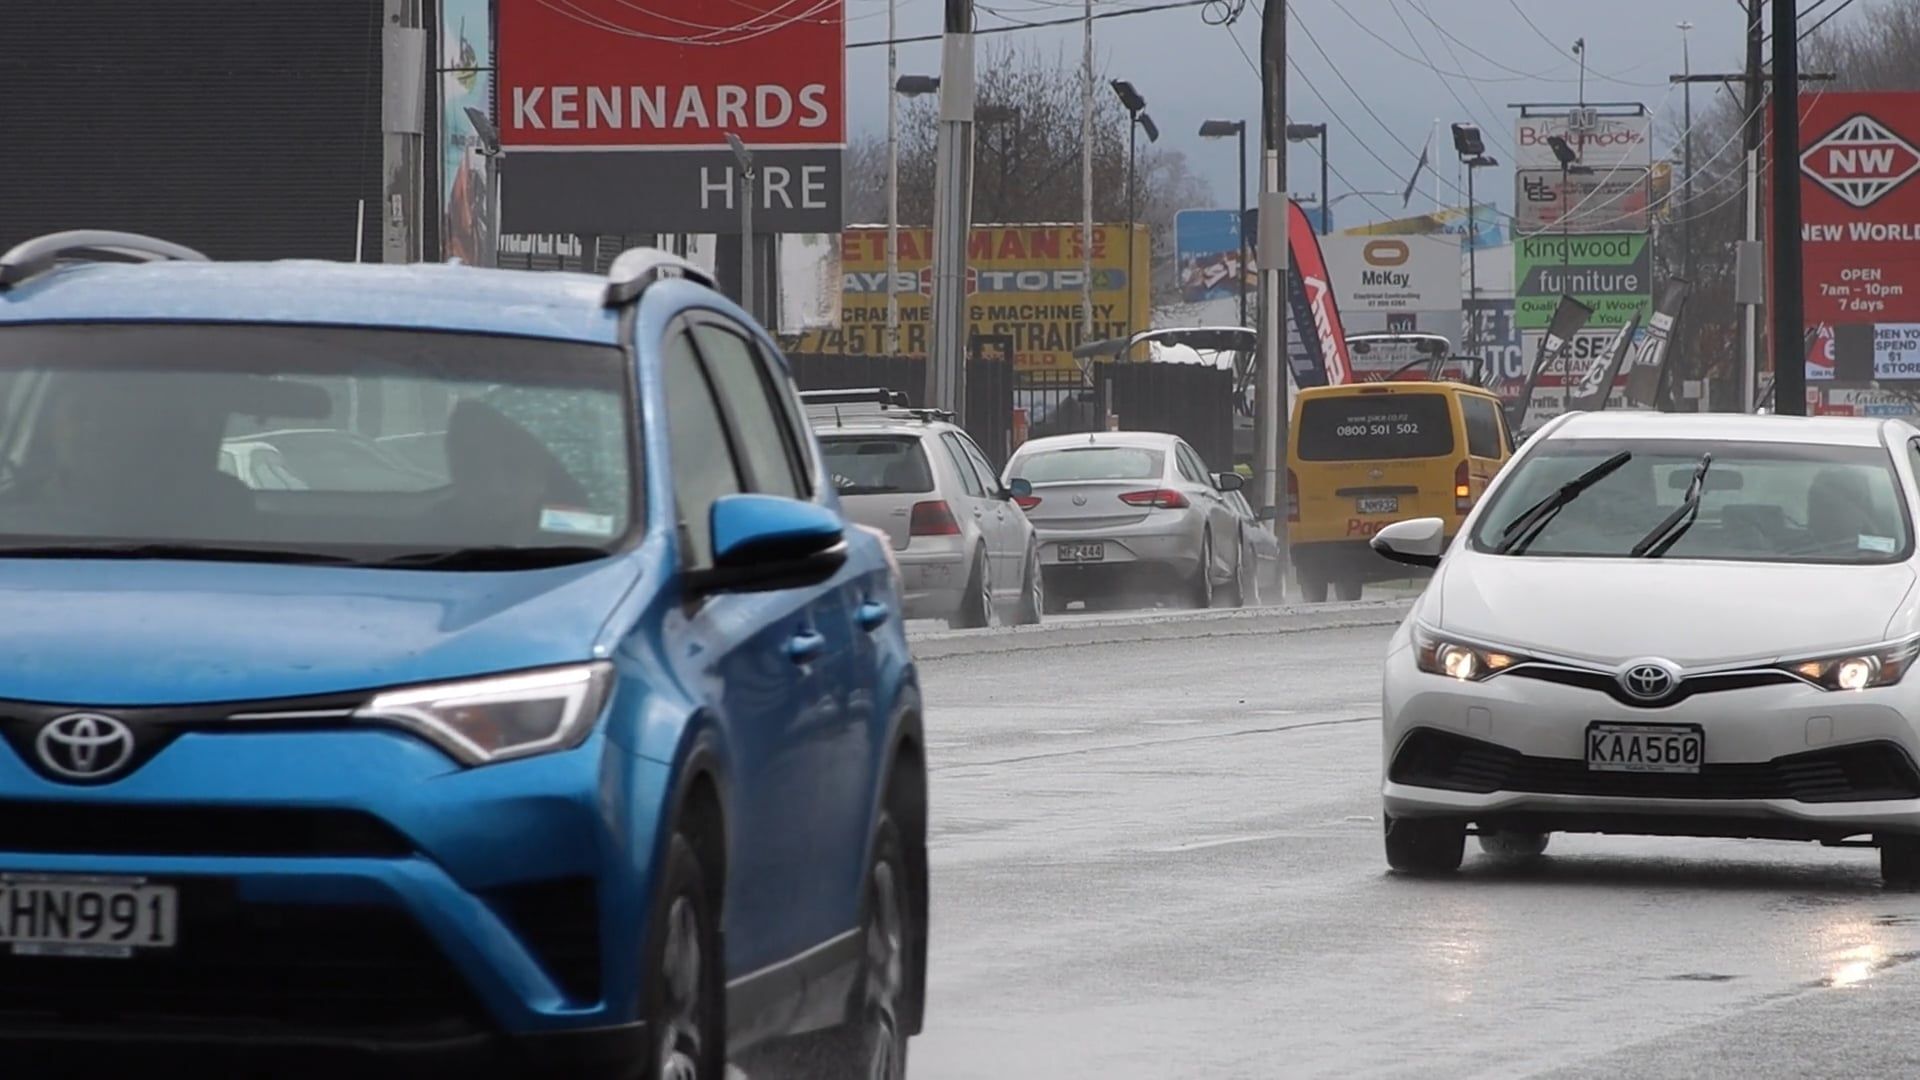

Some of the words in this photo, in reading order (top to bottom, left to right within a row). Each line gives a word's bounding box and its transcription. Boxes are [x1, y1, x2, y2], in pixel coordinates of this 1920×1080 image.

[512, 84, 829, 129] KENNARDS
[1829, 148, 1895, 174] NW
[700, 165, 828, 209] HRE
[1524, 236, 1631, 262] kingwood
[842, 271, 917, 292] AYS
[1362, 271, 1410, 288] McKay
[1539, 270, 1638, 292] furniture
[1841, 269, 1881, 281] OPEN
[1820, 284, 1850, 295] 7am
[1865, 284, 1903, 297] 10pm
[1839, 299, 1847, 310] 7
[1850, 299, 1884, 312] days
[1874, 330, 1900, 339] HEN
[1876, 341, 1917, 350] SPEND
[1336, 425, 1367, 436] 0800
[1370, 424, 1390, 435] 501
[1396, 423, 1418, 434] 502
[1591, 735, 1698, 764] KAA560
[0, 889, 164, 941] HN991
